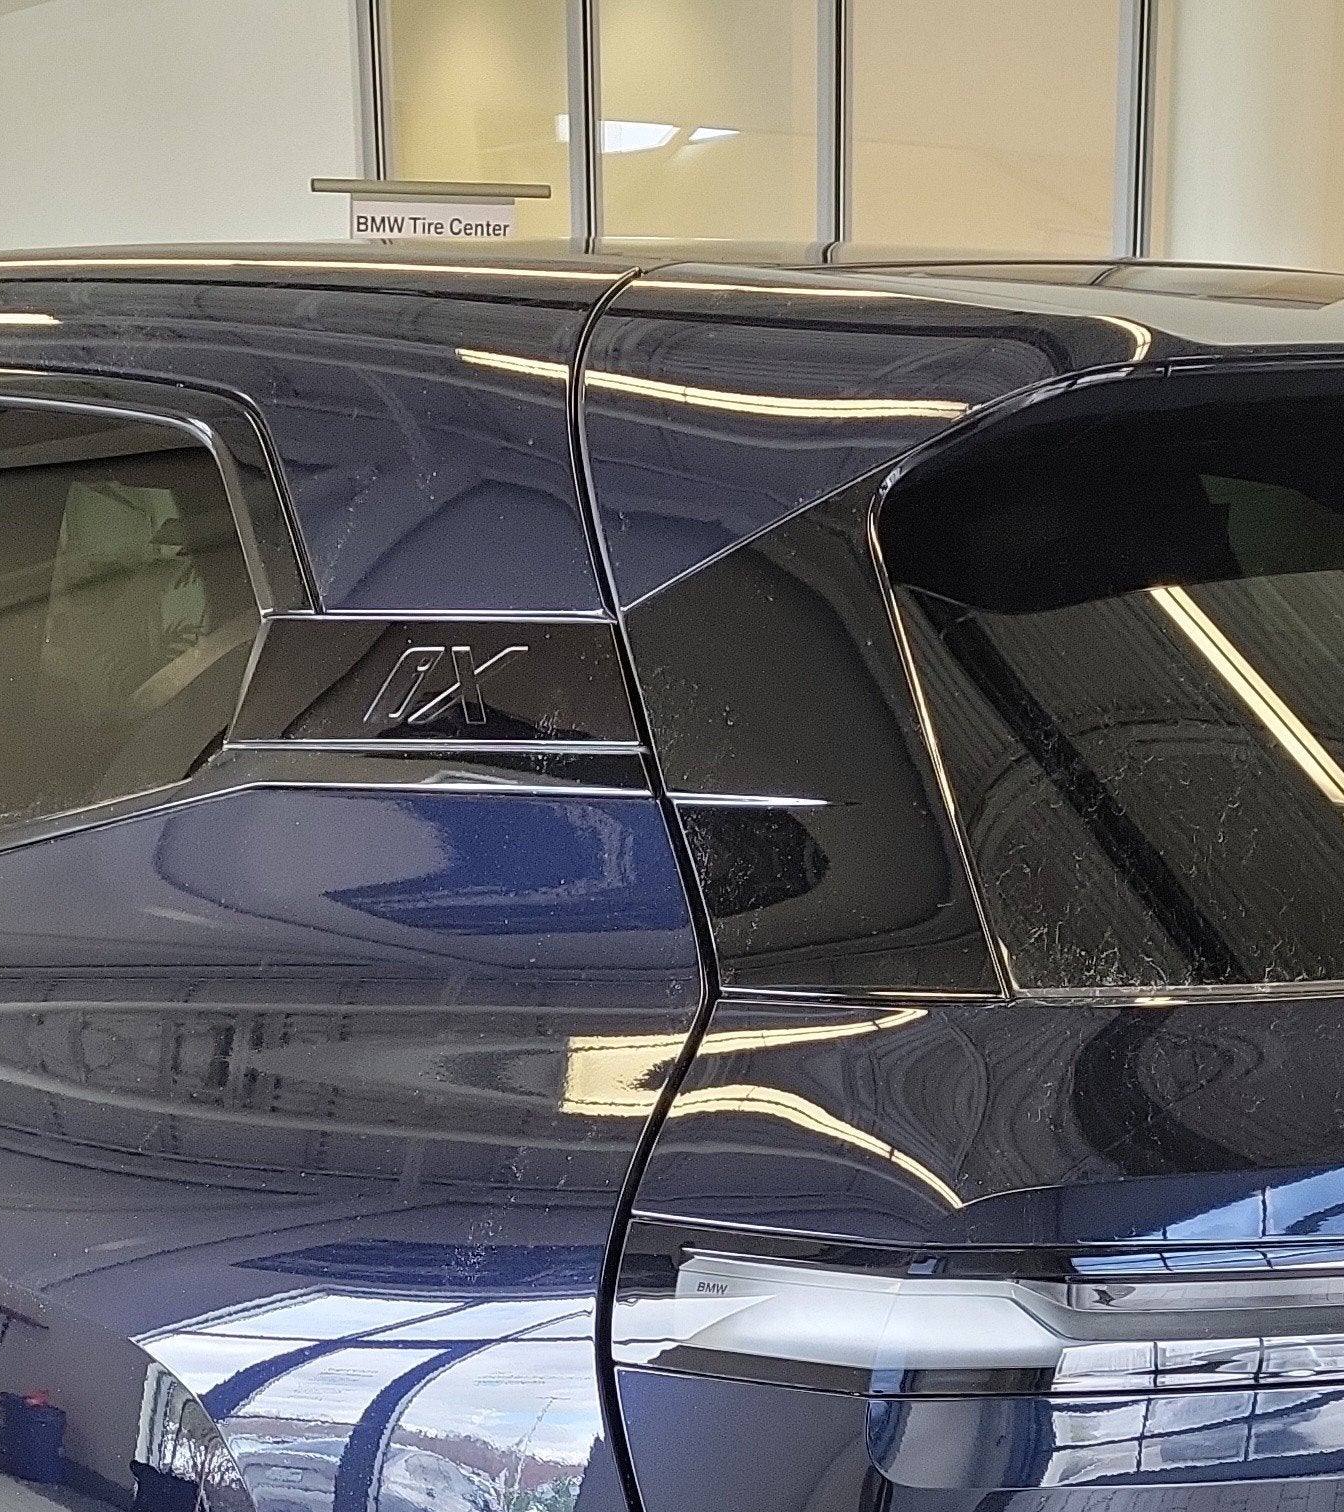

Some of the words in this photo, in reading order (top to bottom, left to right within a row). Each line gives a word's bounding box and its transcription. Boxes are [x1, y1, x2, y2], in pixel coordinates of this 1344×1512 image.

[356, 215, 405, 233] BMW
[408, 216, 444, 235] Tire
[449, 218, 510, 237] Center
[697, 1281, 729, 1295] BMW
